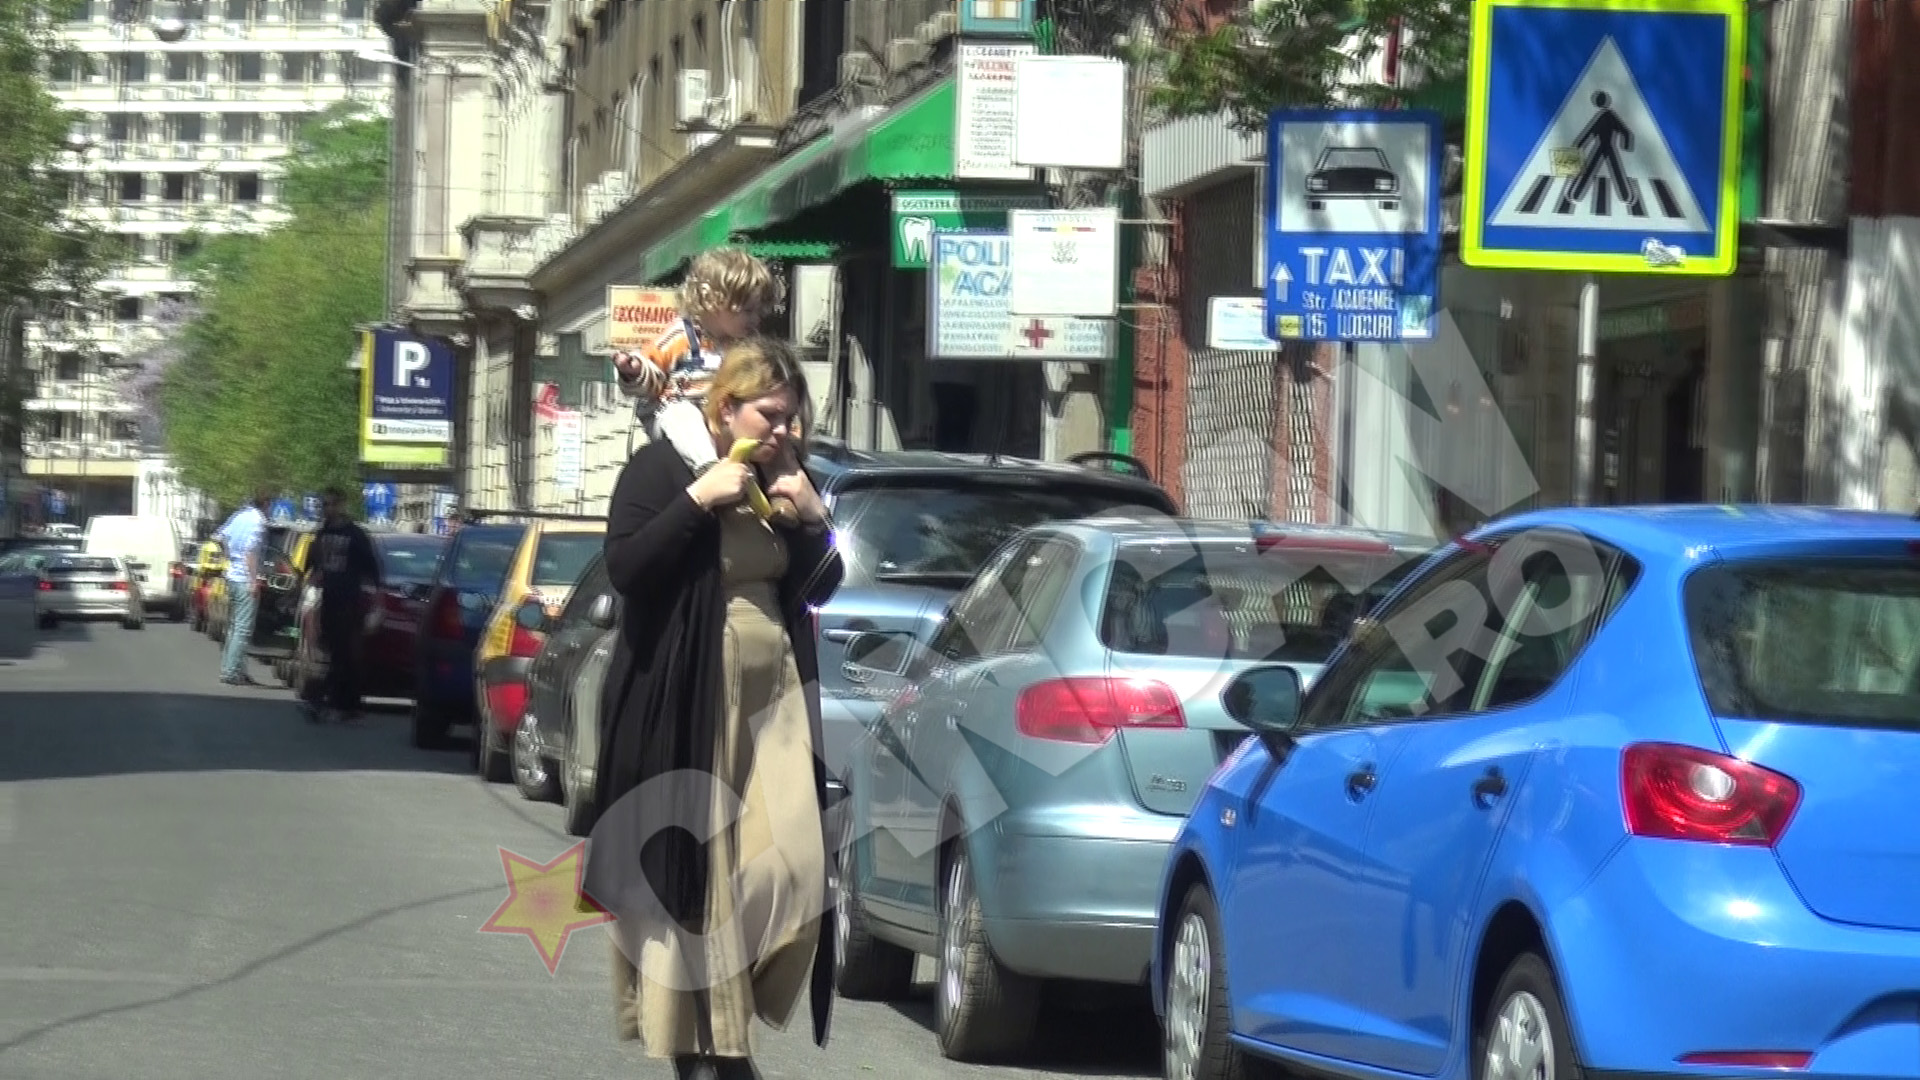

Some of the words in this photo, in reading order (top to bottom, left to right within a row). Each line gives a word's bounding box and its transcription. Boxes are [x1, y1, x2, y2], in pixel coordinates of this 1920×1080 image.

[938, 238, 1011, 266] POLI
[1299, 246, 1404, 286] TAXI
[951, 269, 1012, 296] ACA
[612, 305, 679, 324] EXCHANG
[393, 341, 431, 386] P
